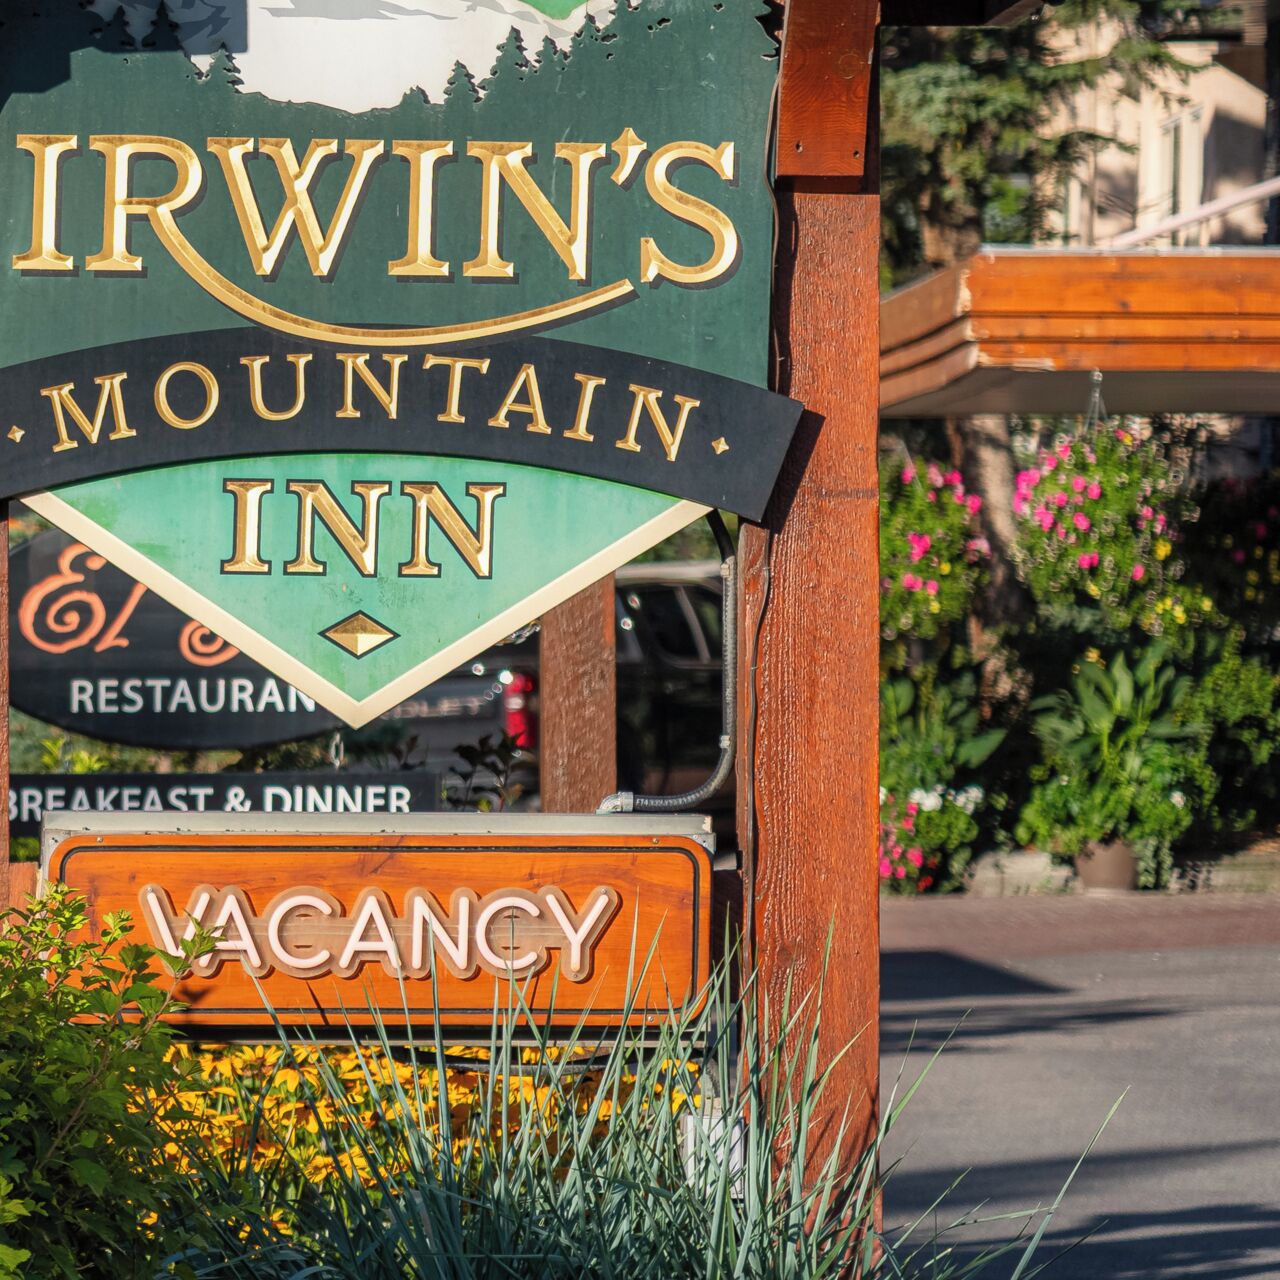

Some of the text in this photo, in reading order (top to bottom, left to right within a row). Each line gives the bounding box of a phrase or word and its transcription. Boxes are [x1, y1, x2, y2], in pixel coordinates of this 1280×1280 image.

[12, 128, 741, 346] IRWIN'S
[41, 353, 701, 462] MOUNTAIN
[220, 478, 507, 578] INN
[69, 678, 317, 714] RESTAURAN
[223, 786, 251, 812] &
[263, 785, 412, 813] DINNER
[143, 891, 611, 974] VACANCY
